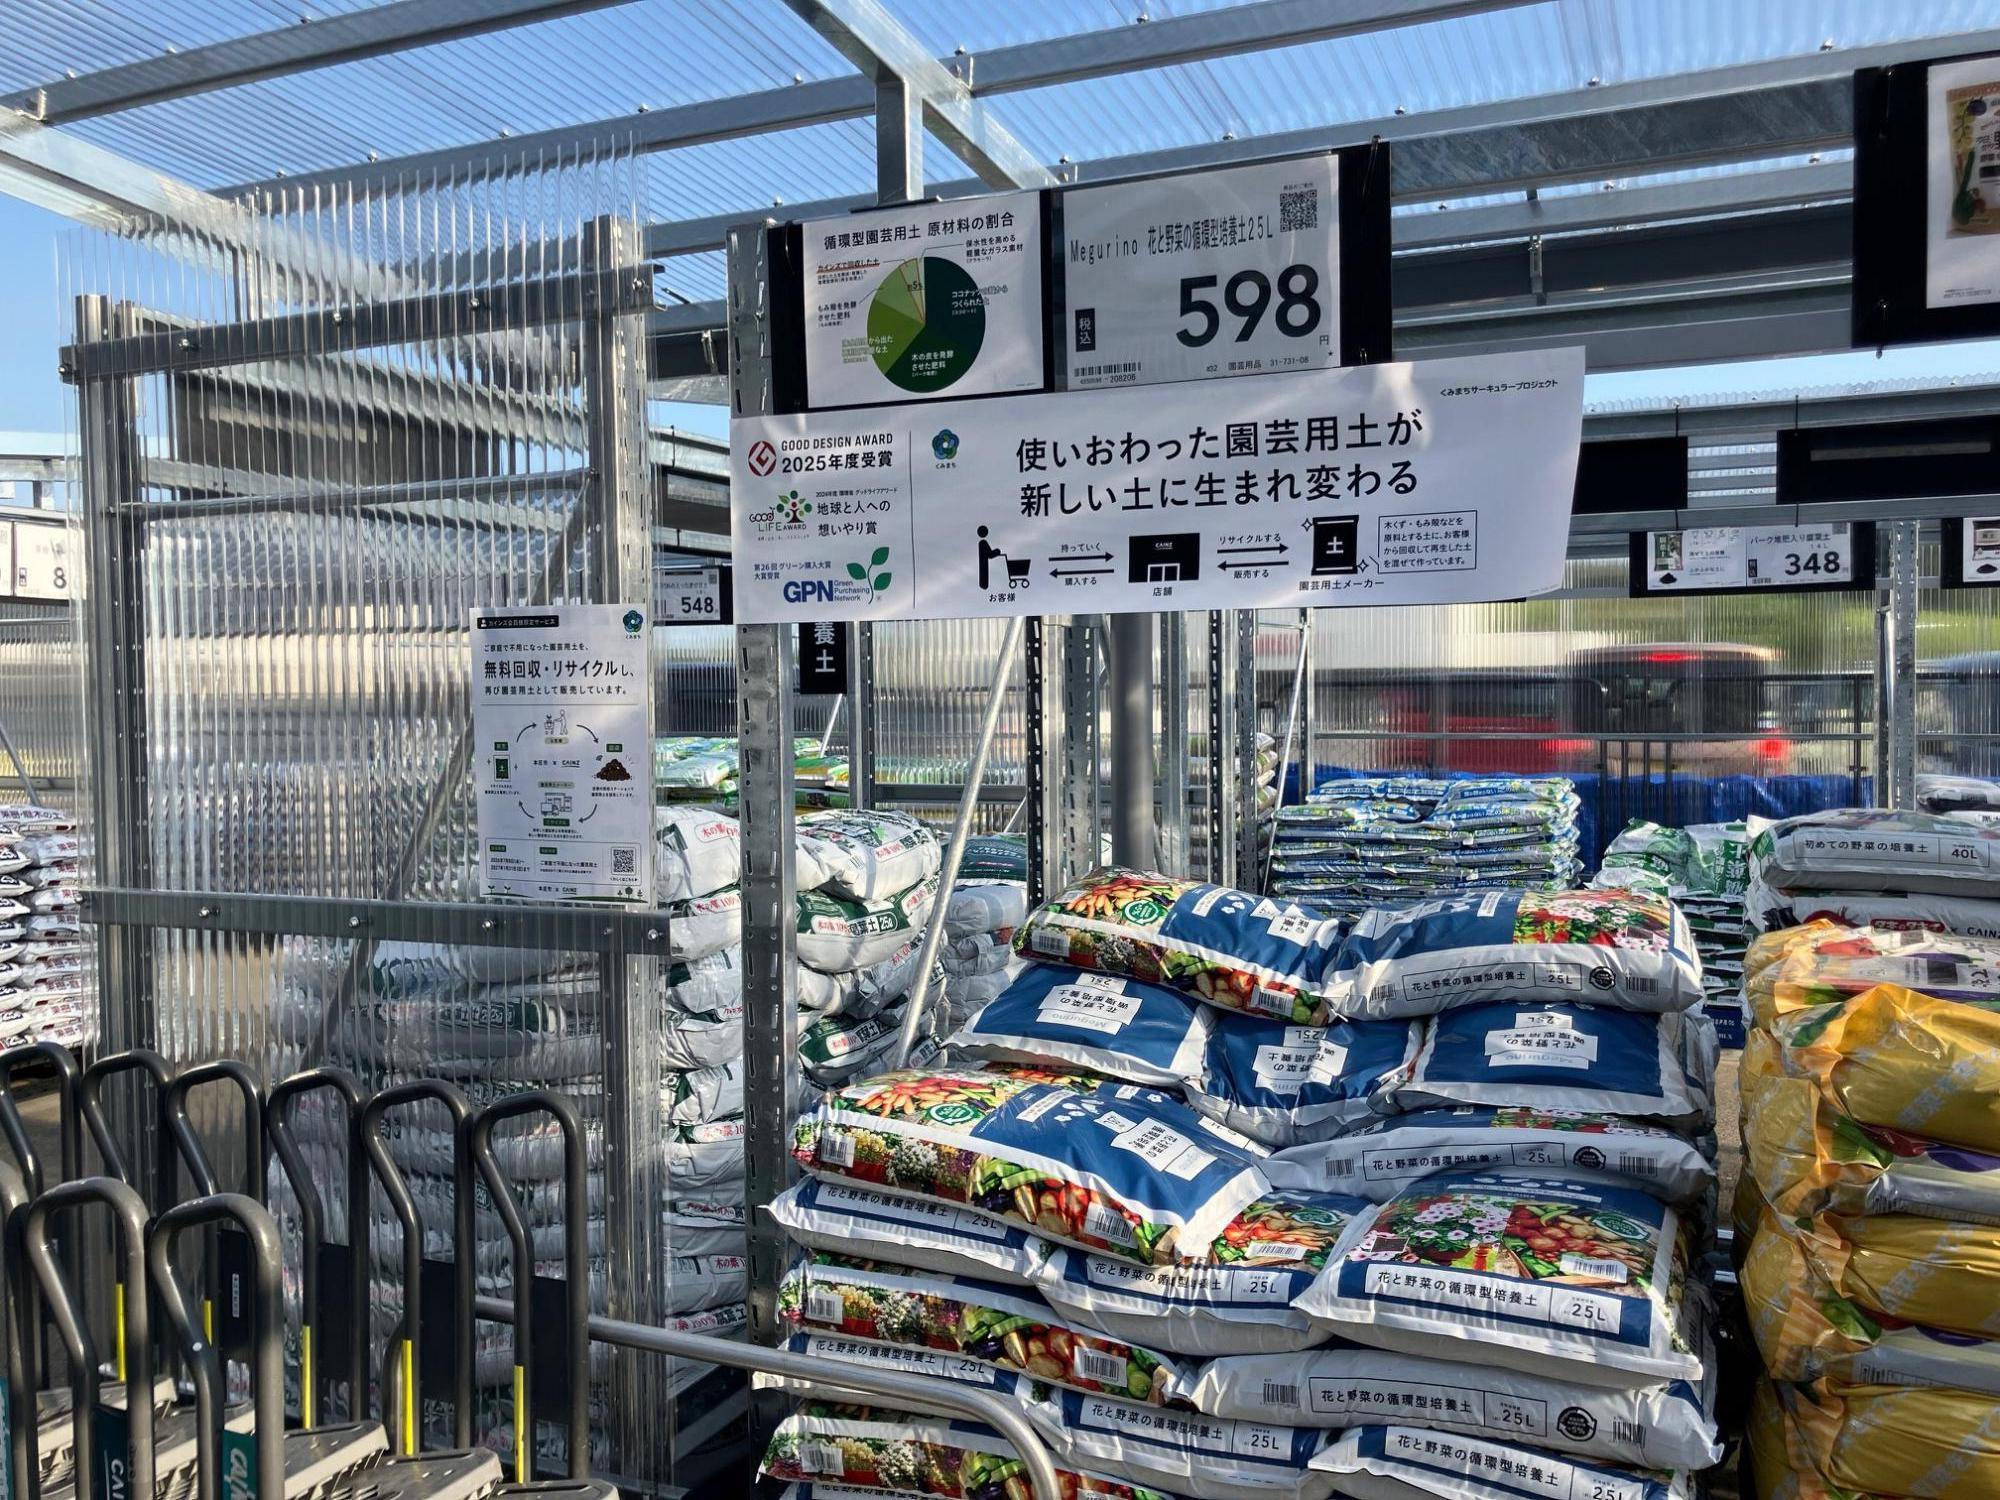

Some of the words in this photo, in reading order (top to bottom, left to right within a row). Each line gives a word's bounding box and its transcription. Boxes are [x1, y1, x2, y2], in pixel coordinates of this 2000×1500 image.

[824, 226, 921, 250] 循環型園芸用土
[928, 212, 1015, 237] 原材料の割合
[1070, 236, 1139, 265] Megurino
[1176, 264, 1321, 348] 598
[1078, 317, 1092, 345] 税込
[1319, 335, 1330, 346] 円
[1440, 379, 1558, 397] くみまちサーキュラープロジェクト
[782, 439, 809, 451] GOOD
[813, 436, 851, 449] DESIGN
[855, 433, 893, 446] AWARD
[1016, 406, 1423, 473] 使いおわった園芸用土が
[782, 450, 893, 473] 2025年度受賞
[936, 462, 957, 470] くみまち
[1020, 460, 1418, 517] 新しい土に生まれ変わる
[817, 500, 891, 516] 地球と人への
[758, 522, 783, 532] LIFE
[818, 521, 877, 537] 想いやり賞
[1061, 542, 1101, 553] 持っていく
[1219, 532, 1282, 545] リサイクルする
[1325, 536, 1345, 556] 土
[1785, 551, 1840, 576] 348
[1064, 576, 1097, 586] 購入する
[1234, 568, 1269, 580] 販売する
[783, 580, 834, 603] GPN
[834, 587, 870, 595] Purchasing
[1152, 586, 1173, 597] 店舗
[1298, 577, 1385, 591] 園芸用土メーカー
[681, 596, 714, 614] 548
[989, 593, 1016, 603] お客様
[484, 660, 635, 679] 無料回収・リサイクルし、
[1805, 839, 1928, 853] 初めての野菜の培養土
[1951, 849, 1977, 860] 40L
[1089, 976, 1113, 986] 25L
[1411, 970, 1526, 992] 花と野菜の循環型培養土
[1548, 974, 1573, 985] 25L
[1060, 997, 1117, 1014] 花と野菜の
[1295, 1030, 1320, 1040] 25L
[1373, 1152, 1503, 1171] 花と野菜の循環型培養土
[1528, 1151, 1555, 1164] 25L
[827, 1186, 948, 1217] 花と野菜の循環型培養土
[972, 1214, 997, 1230] 25L
[1250, 1281, 1277, 1295] 25L
[1377, 1270, 1538, 1307] 花と野菜の循環型培養土
[1572, 1303, 1607, 1323] 25L
[815, 1340, 936, 1364] 花と野菜の循環型培養土
[959, 1359, 985, 1374] 25L
[1321, 1388, 1472, 1414] 花と野菜の循環型培養土
[1502, 1408, 1535, 1428] 25L
[1250, 1434, 1279, 1451] 25L
[1398, 1434, 1559, 1487] 花と野菜の循環型培養土
